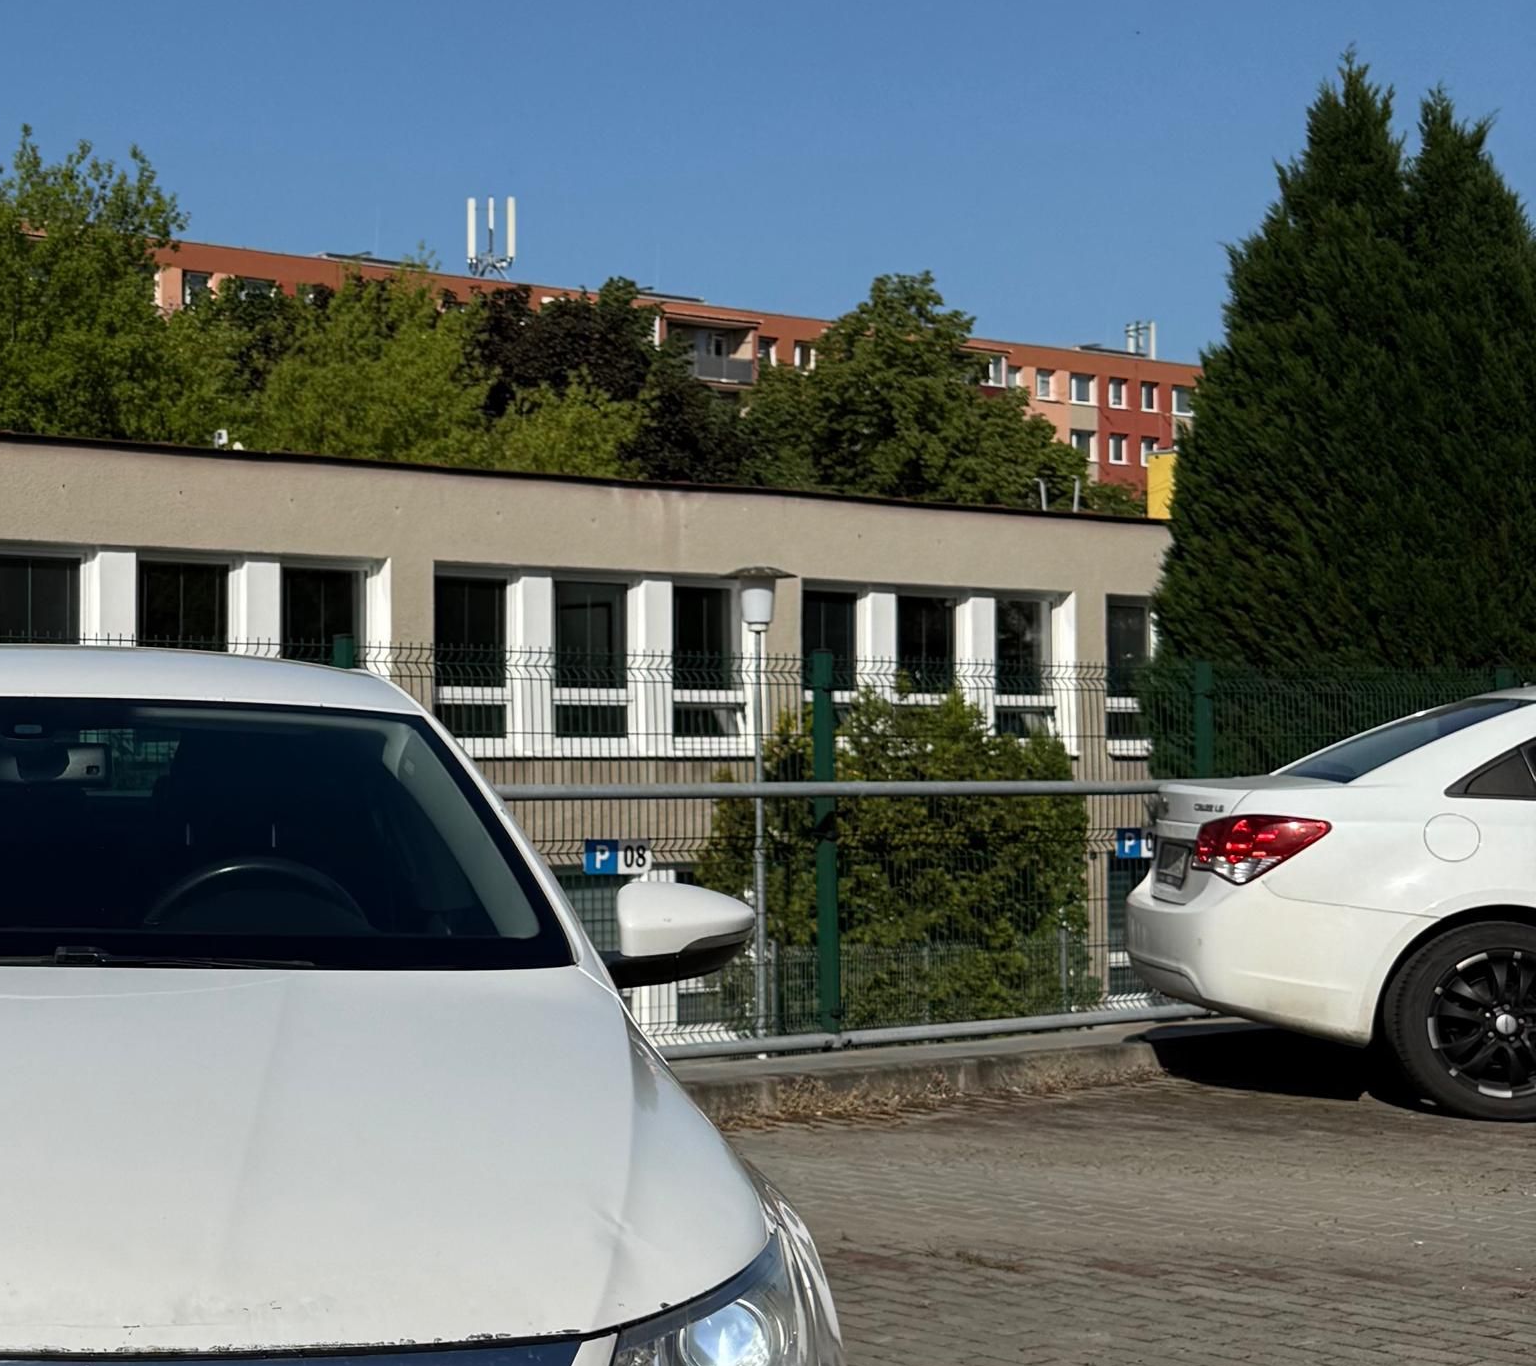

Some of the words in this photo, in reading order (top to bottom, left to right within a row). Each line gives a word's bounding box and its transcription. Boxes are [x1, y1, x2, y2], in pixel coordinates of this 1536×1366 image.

[1124, 833, 1135, 854] P
[595, 845, 610, 869] P
[624, 845, 646, 868] 08
